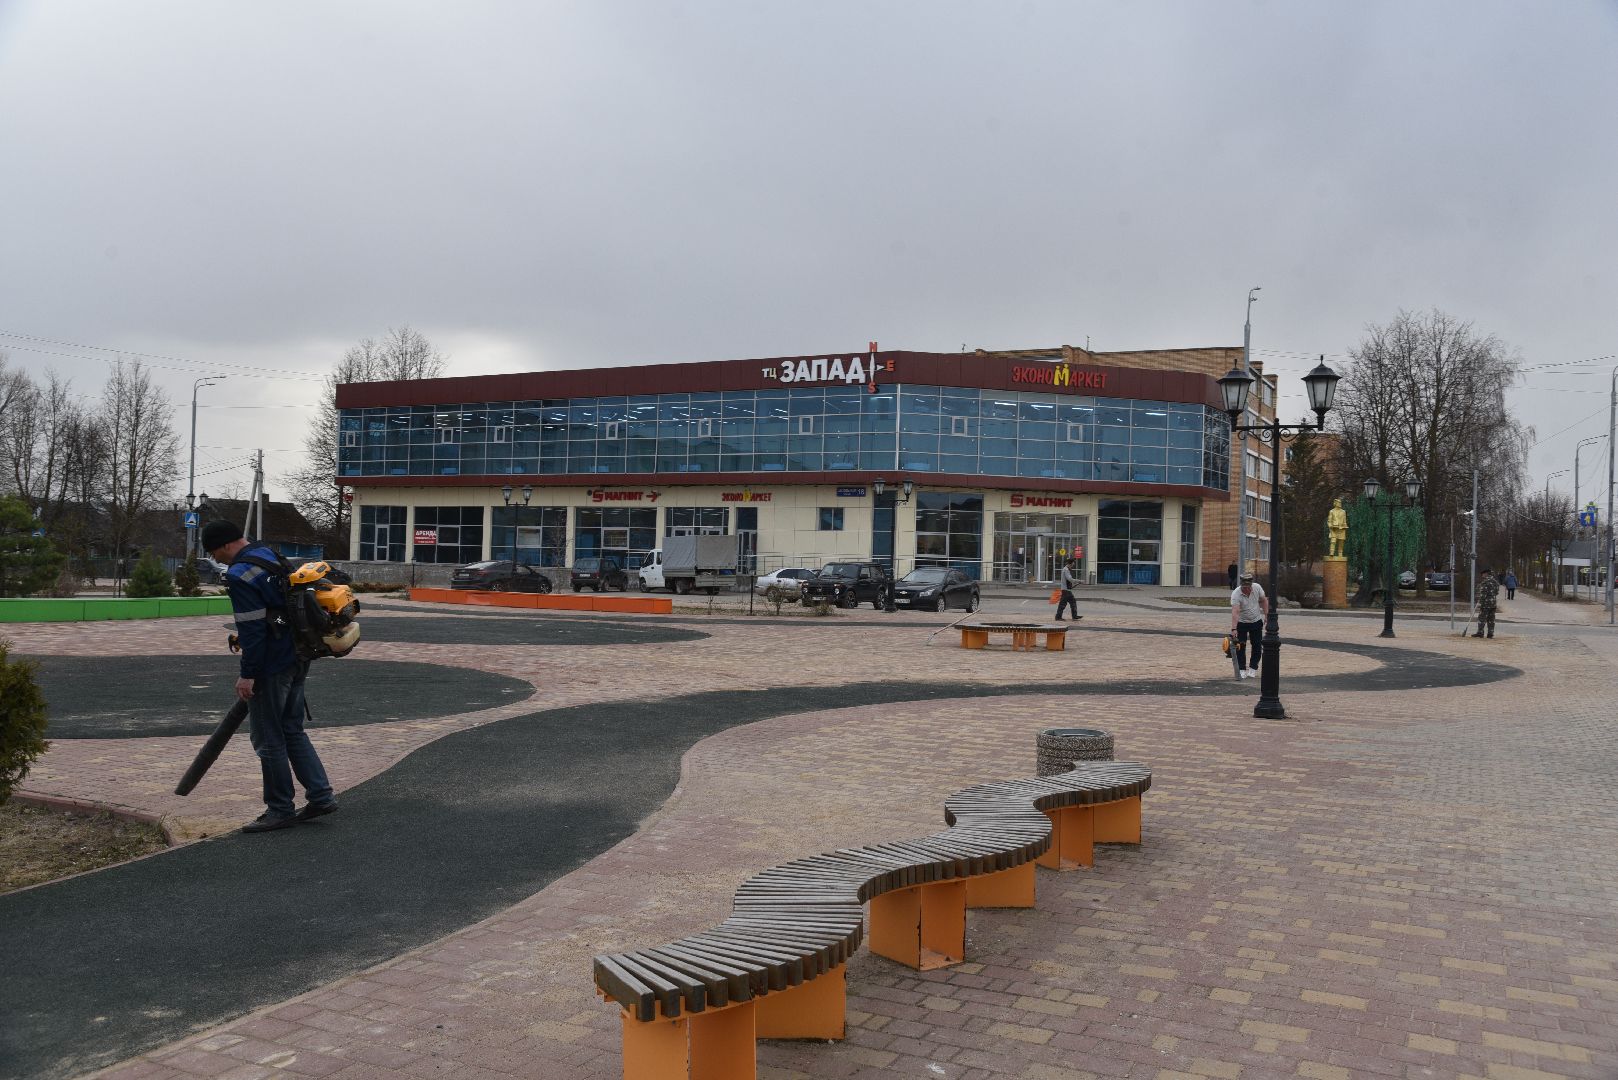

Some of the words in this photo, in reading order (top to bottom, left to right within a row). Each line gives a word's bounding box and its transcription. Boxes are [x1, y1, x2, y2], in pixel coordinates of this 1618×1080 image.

[762, 367, 777, 379] ТЦ
[780, 356, 866, 384] ЗАПАД
[886, 359, 896, 371] E
[1025, 496, 1074, 507] МАГНИТ
